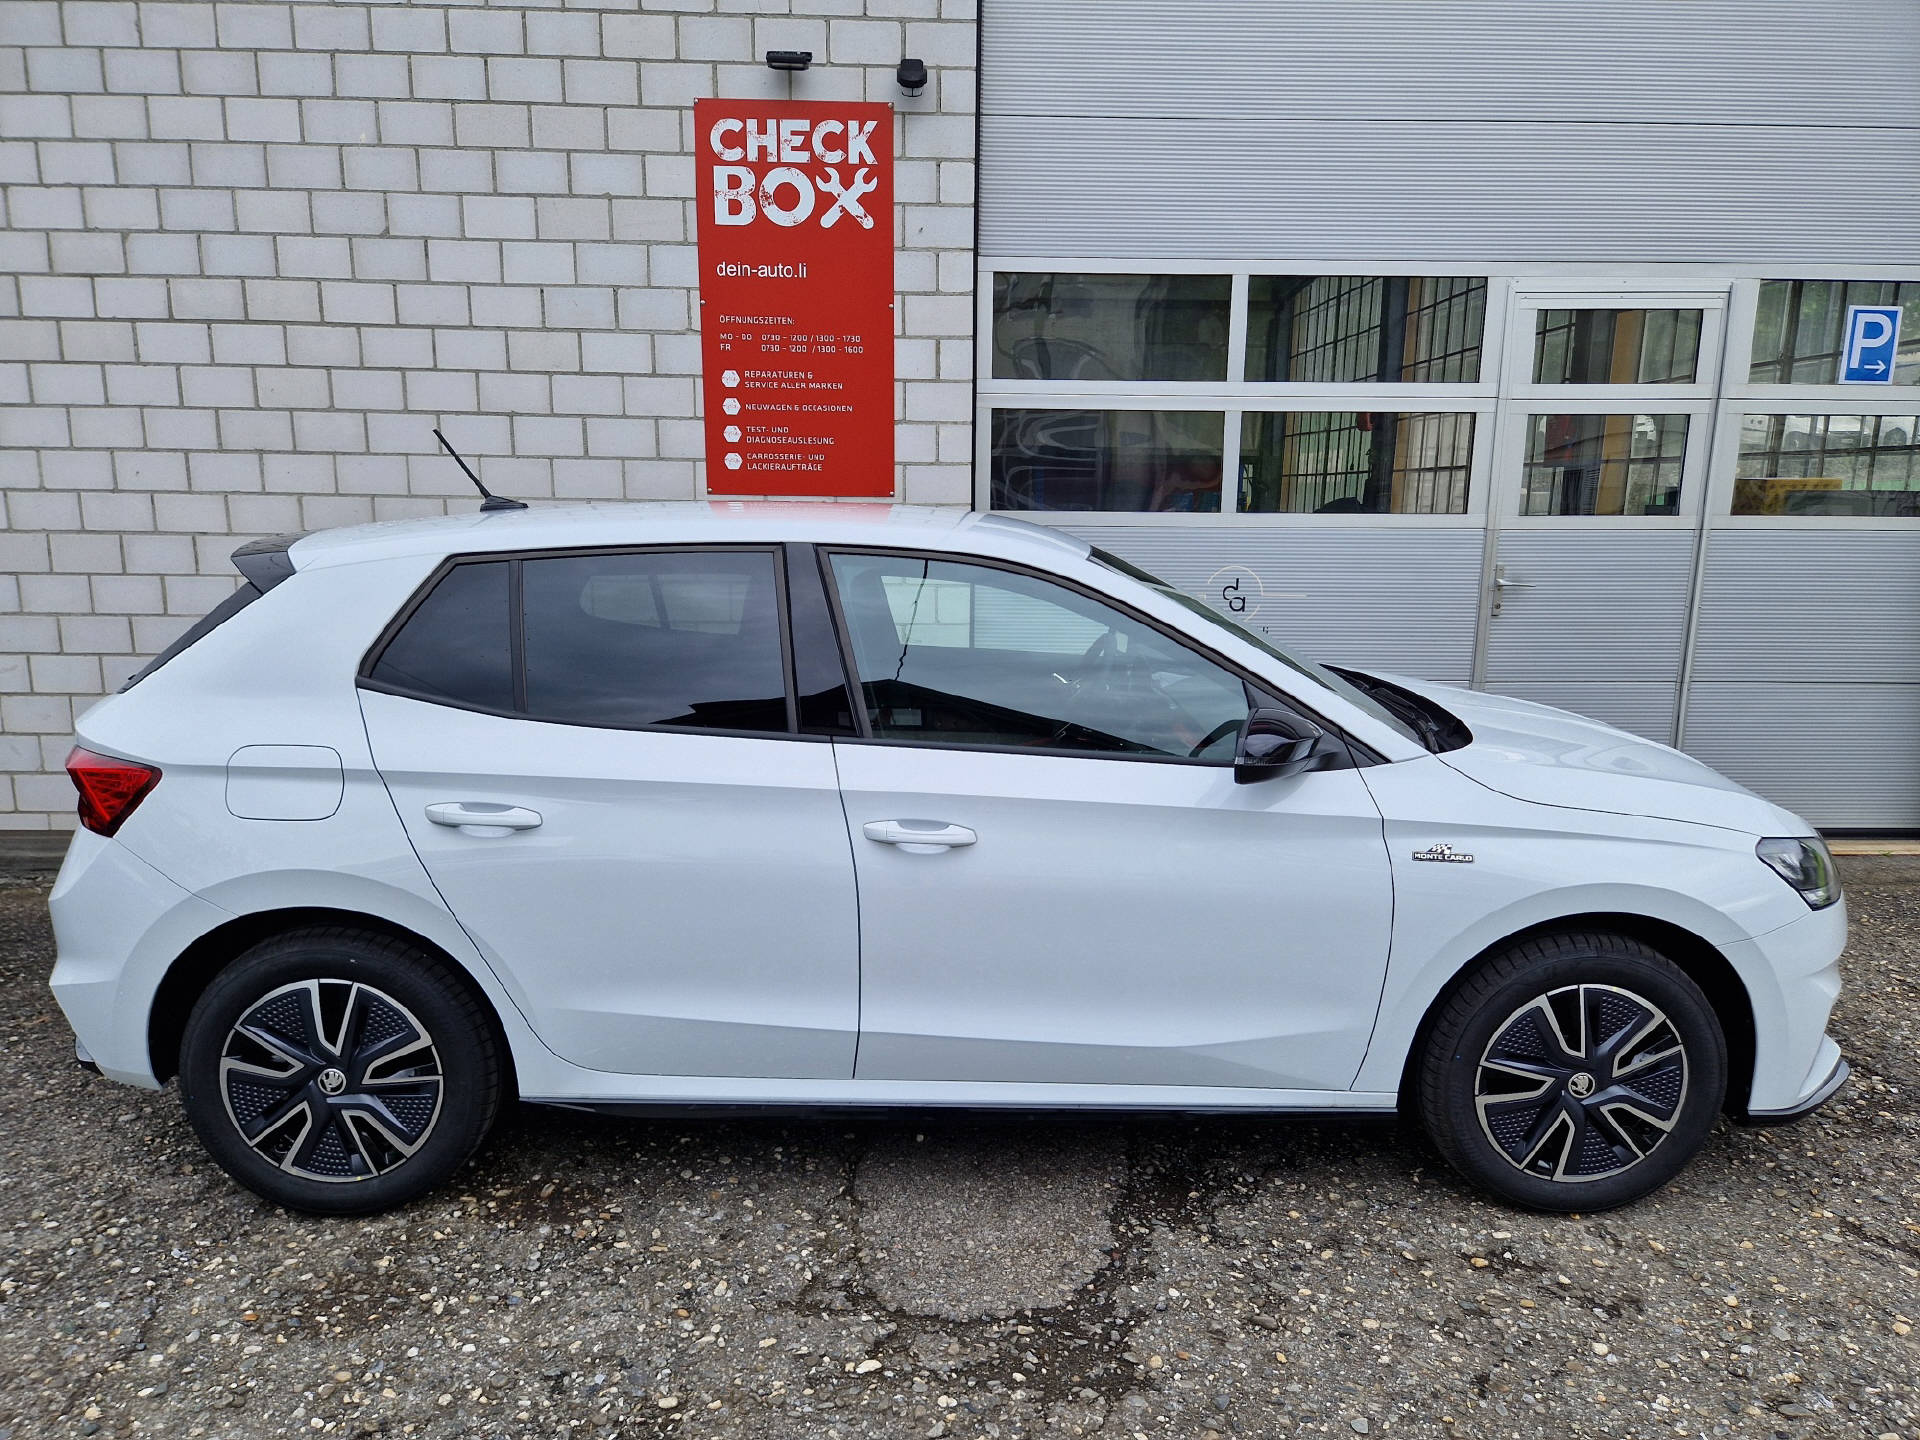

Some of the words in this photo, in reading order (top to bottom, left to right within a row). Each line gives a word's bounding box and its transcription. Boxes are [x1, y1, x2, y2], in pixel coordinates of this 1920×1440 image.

[710, 118, 878, 165] CHECK
[713, 165, 878, 229] BOX
[716, 261, 807, 278] dein-auto.li
[719, 314, 795, 325] ÖFFNUNGSZEITEN:
[789, 334, 808, 342] 1200
[843, 335, 861, 343] 1730
[1849, 312, 1893, 369] P
[720, 343, 731, 351] FR
[761, 344, 780, 352] 0730
[844, 346, 864, 354] 1600
[744, 370, 805, 379] REPARATUREN
[744, 381, 779, 389] SERVICE
[808, 382, 843, 390] MARKEN
[745, 403, 792, 411] NEUWAGEN
[802, 404, 853, 412] OCCASIONEN
[746, 435, 835, 445] DIAGNOSEAUSLESUNG
[747, 463, 823, 471] LACKIERAUFTRÄGE
